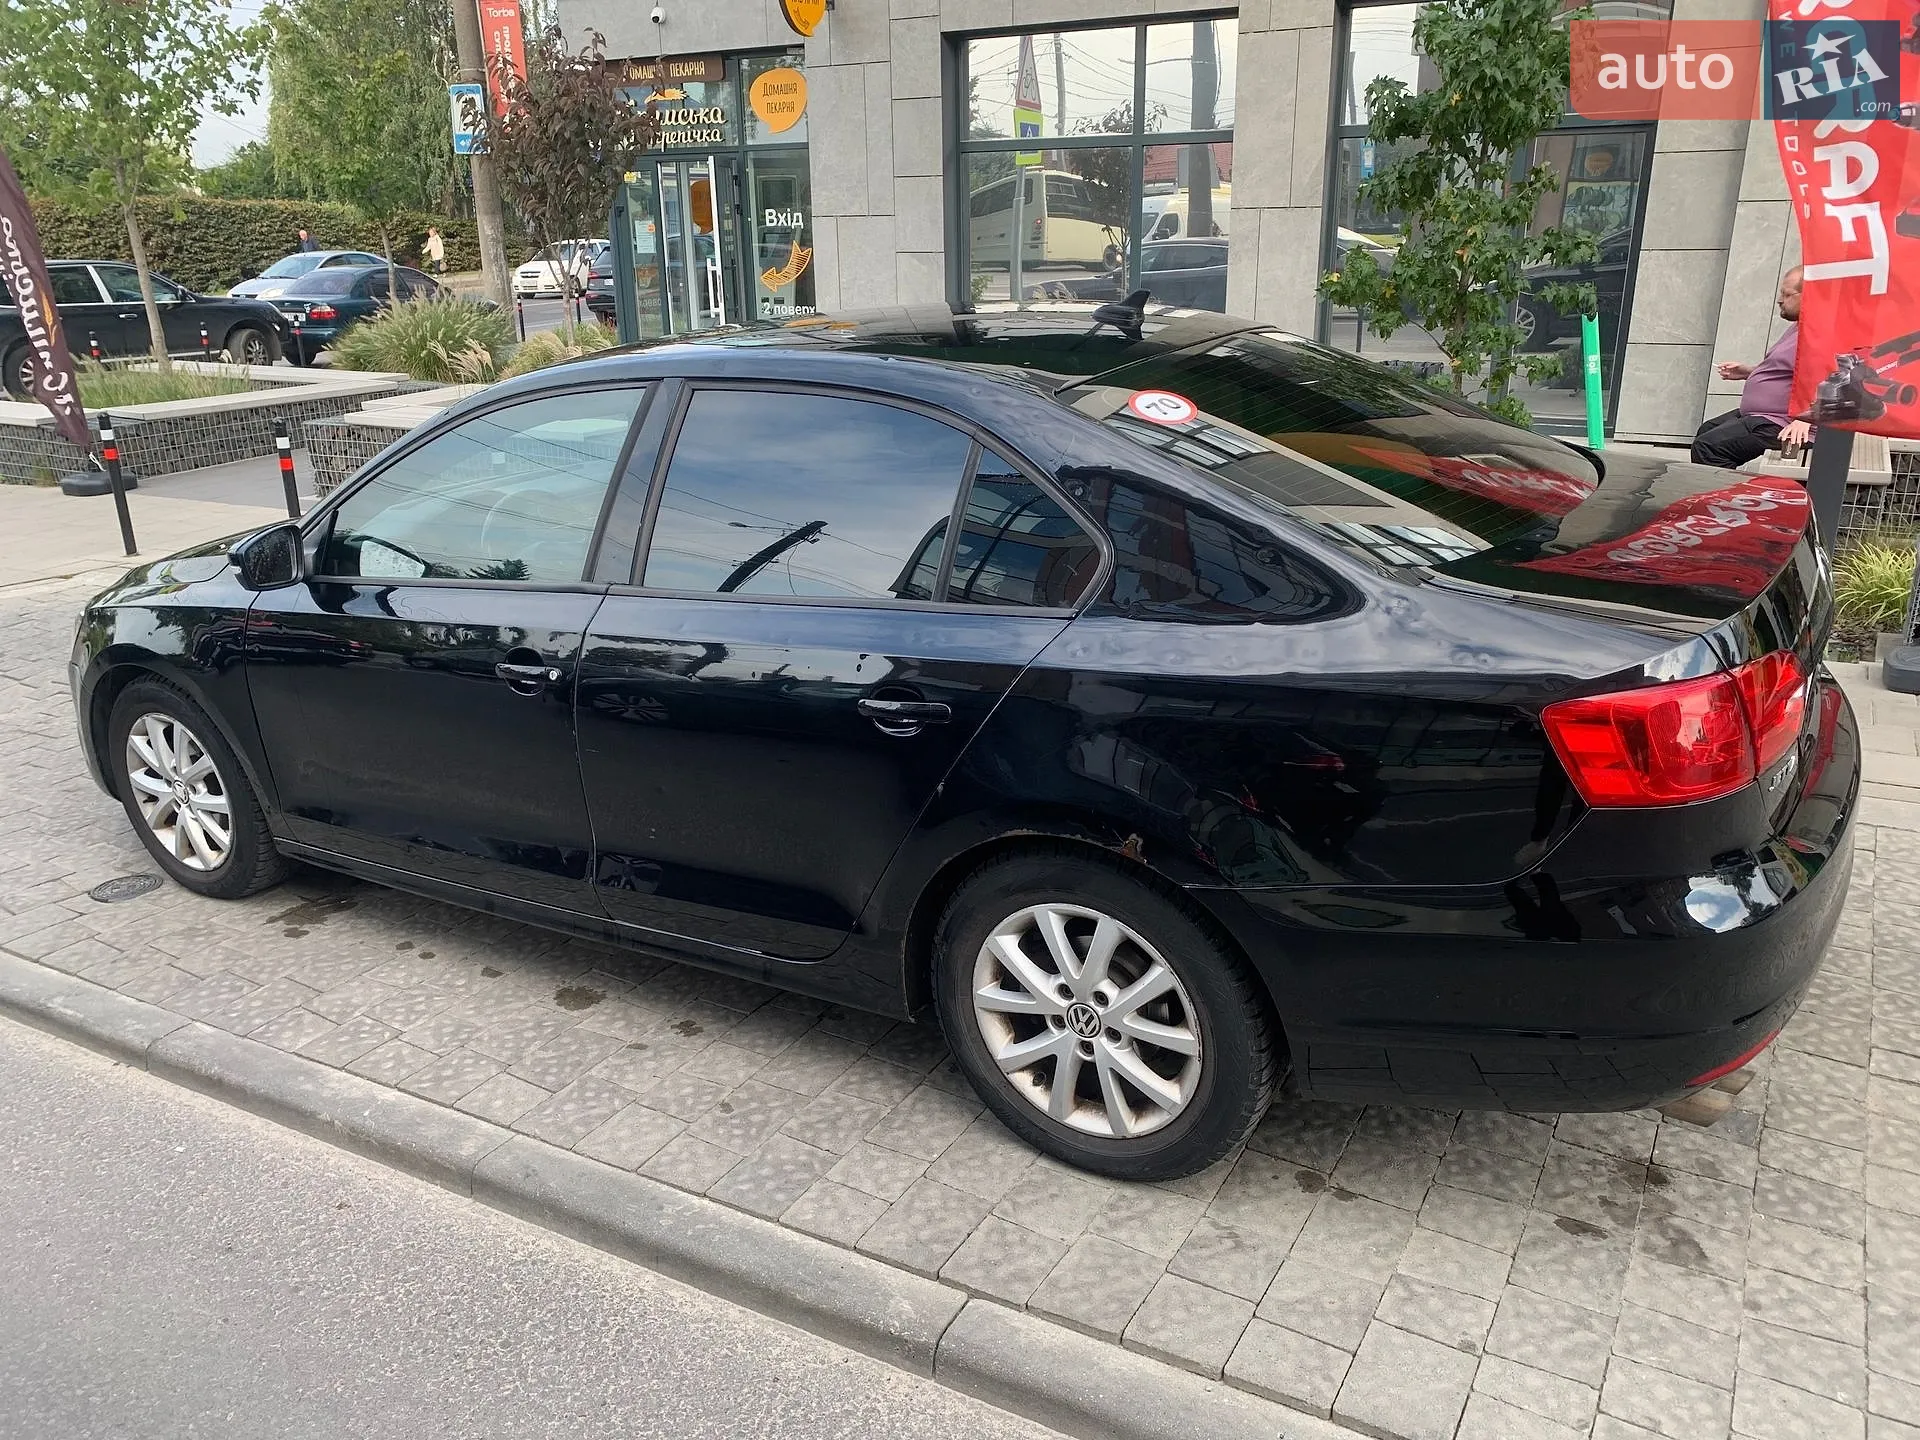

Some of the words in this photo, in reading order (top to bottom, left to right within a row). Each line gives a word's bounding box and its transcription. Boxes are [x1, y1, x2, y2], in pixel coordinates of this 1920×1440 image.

[486, 7, 515, 17] Torba
[669, 61, 705, 77] ПЕКАРНЯ
[766, 101, 795, 114] ПЕКАРНЯ
[765, 208, 803, 229] Вхід
[763, 303, 770, 314] 2
[1145, 398, 1181, 415] 70
